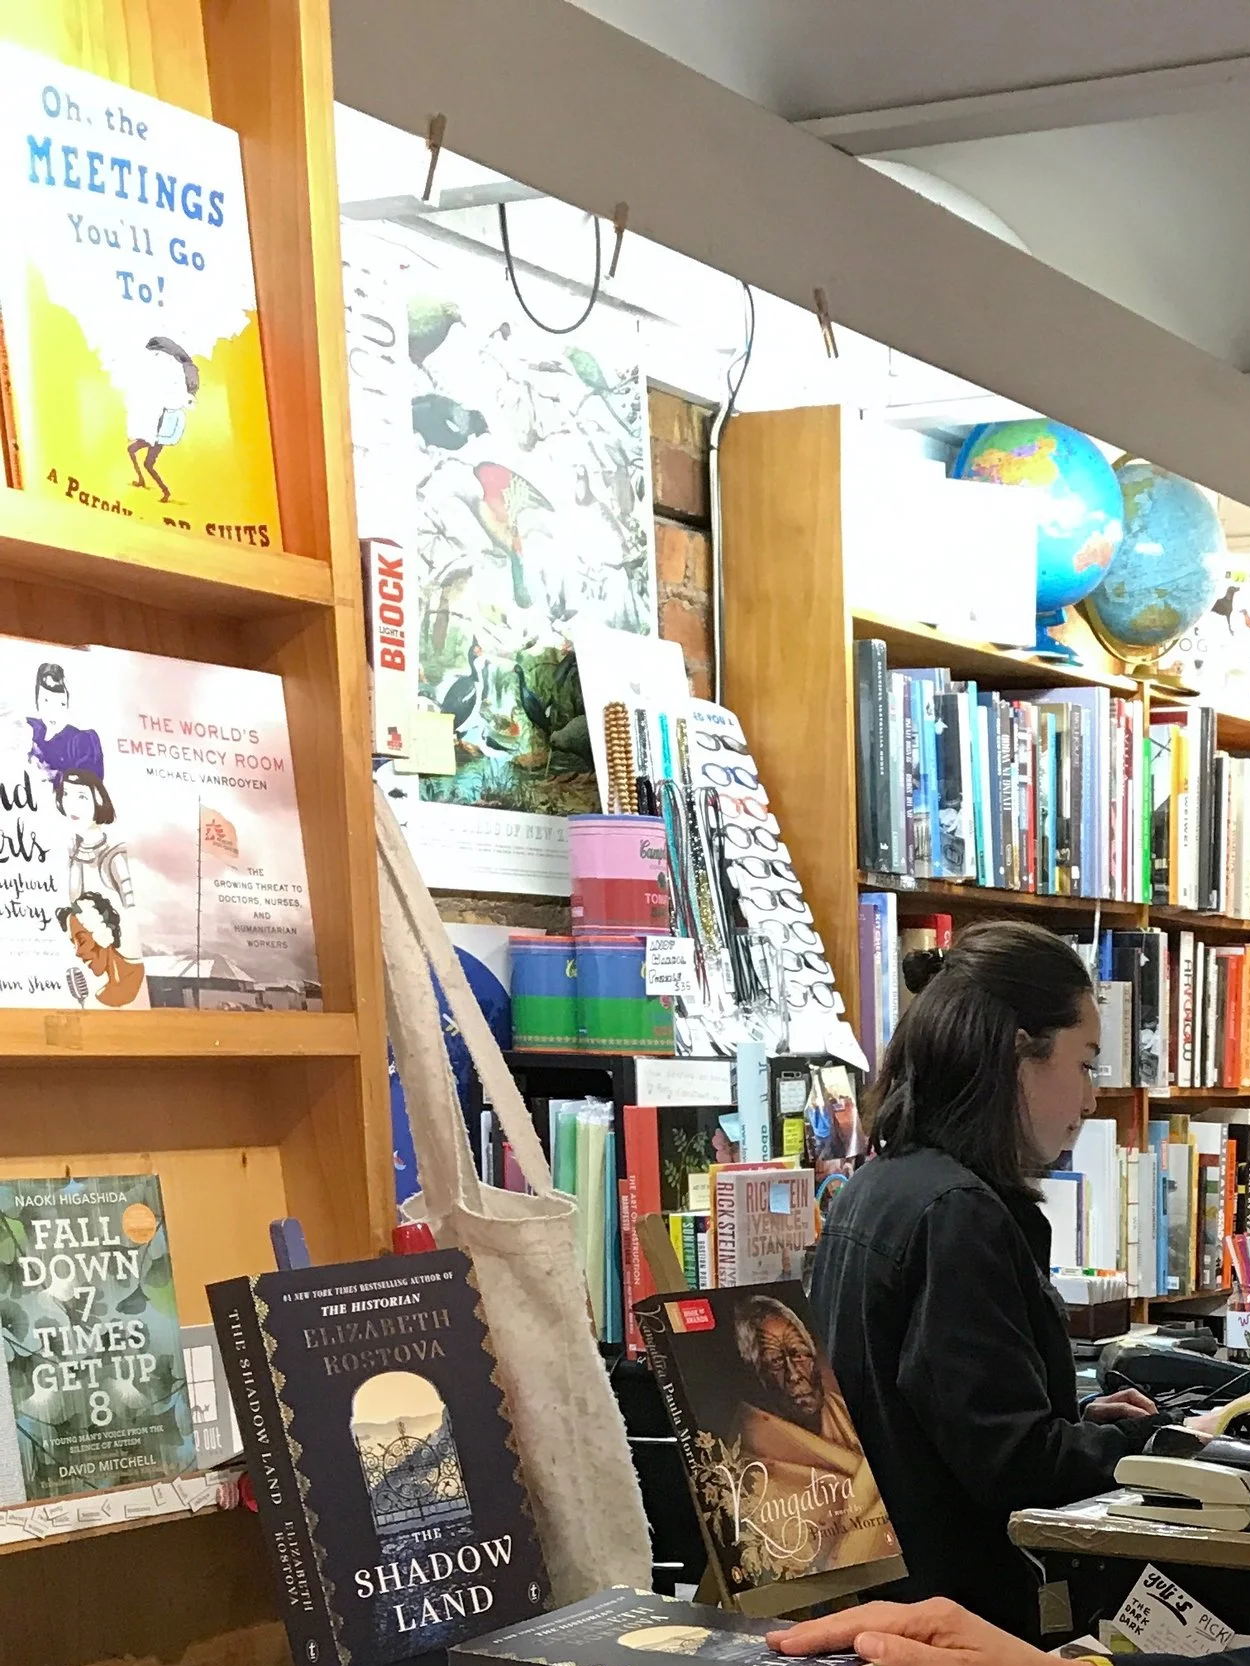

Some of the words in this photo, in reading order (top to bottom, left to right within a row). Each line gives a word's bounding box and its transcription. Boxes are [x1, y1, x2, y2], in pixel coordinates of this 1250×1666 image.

[105, 106, 150, 141] the
[26, 134, 226, 228] MEETINGS
[67, 212, 153, 257] You'll
[168, 238, 206, 272] Go
[116, 270, 165, 308] To!
[139, 713, 175, 735] THE
[179, 719, 259, 745] WORLD'S
[117, 738, 227, 767] EMERGENCY
[235, 749, 285, 773] ROOM
[146, 767, 196, 784] MICHAEL
[200, 773, 268, 791] VANROOYEN
[214, 879, 253, 890] GROWING
[256, 882, 289, 892] THREAT
[292, 884, 303, 893] TO
[248, 867, 264, 877] THE
[219, 894, 262, 907] DOCTORS,
[253, 911, 271, 920] AND
[234, 925, 297, 935] HUMANITARIAN
[247, 940, 288, 949] WORKERS
[14, 1194, 57, 1208] NAOKI
[59, 1192, 128, 1205] HIGASHIDA
[717, 1181, 736, 1219] RICK
[31, 1216, 121, 1250] FALL
[717, 1222, 736, 1264] STEIN
[18, 1250, 140, 1287] DOWN
[294, 1290, 310, 1301] NEW
[311, 1287, 334, 1299] YORK
[334, 1283, 358, 1297] TIMES
[359, 1277, 409, 1294] BESTSELLING
[410, 1272, 441, 1289] AUTHOR
[442, 1270, 454, 1281] OF
[73, 1287, 97, 1323] 7
[321, 1303, 348, 1317] THE
[350, 1293, 421, 1314] HISTORIAN
[32, 1320, 146, 1359] TIMES
[304, 1308, 452, 1349] ELIZABETH
[31, 1358, 103, 1392] GET
[112, 1353, 157, 1383] UP
[323, 1341, 445, 1376] KOSTOVA
[88, 1390, 112, 1427] 8
[227, 1308, 246, 1352] THE
[238, 1357, 270, 1446] SHADOW
[260, 1449, 282, 1507] LAND
[50, 1435, 78, 1446] YOUNG
[79, 1433, 102, 1443] MAN'S
[102, 1430, 126, 1439] VOICE
[127, 1427, 148, 1437] FROM
[150, 1425, 164, 1433] THE
[69, 1442, 99, 1453] SILENCE
[101, 1440, 112, 1449] OF
[113, 1437, 141, 1447] AUTISM
[59, 1463, 96, 1479] DAVID
[99, 1454, 157, 1472] MITCHELL
[714, 1460, 856, 1562] Rangatira
[411, 1527, 442, 1543] THE
[273, 1530, 300, 1607] KOSTOVA
[284, 1520, 314, 1613] ELIZABETH
[353, 1533, 513, 1599] SHADOW
[393, 1584, 495, 1633] LAND
[1119, 1613, 1144, 1635] DARK
[1125, 1604, 1150, 1626] DARK
[1132, 1598, 1150, 1616] THE
